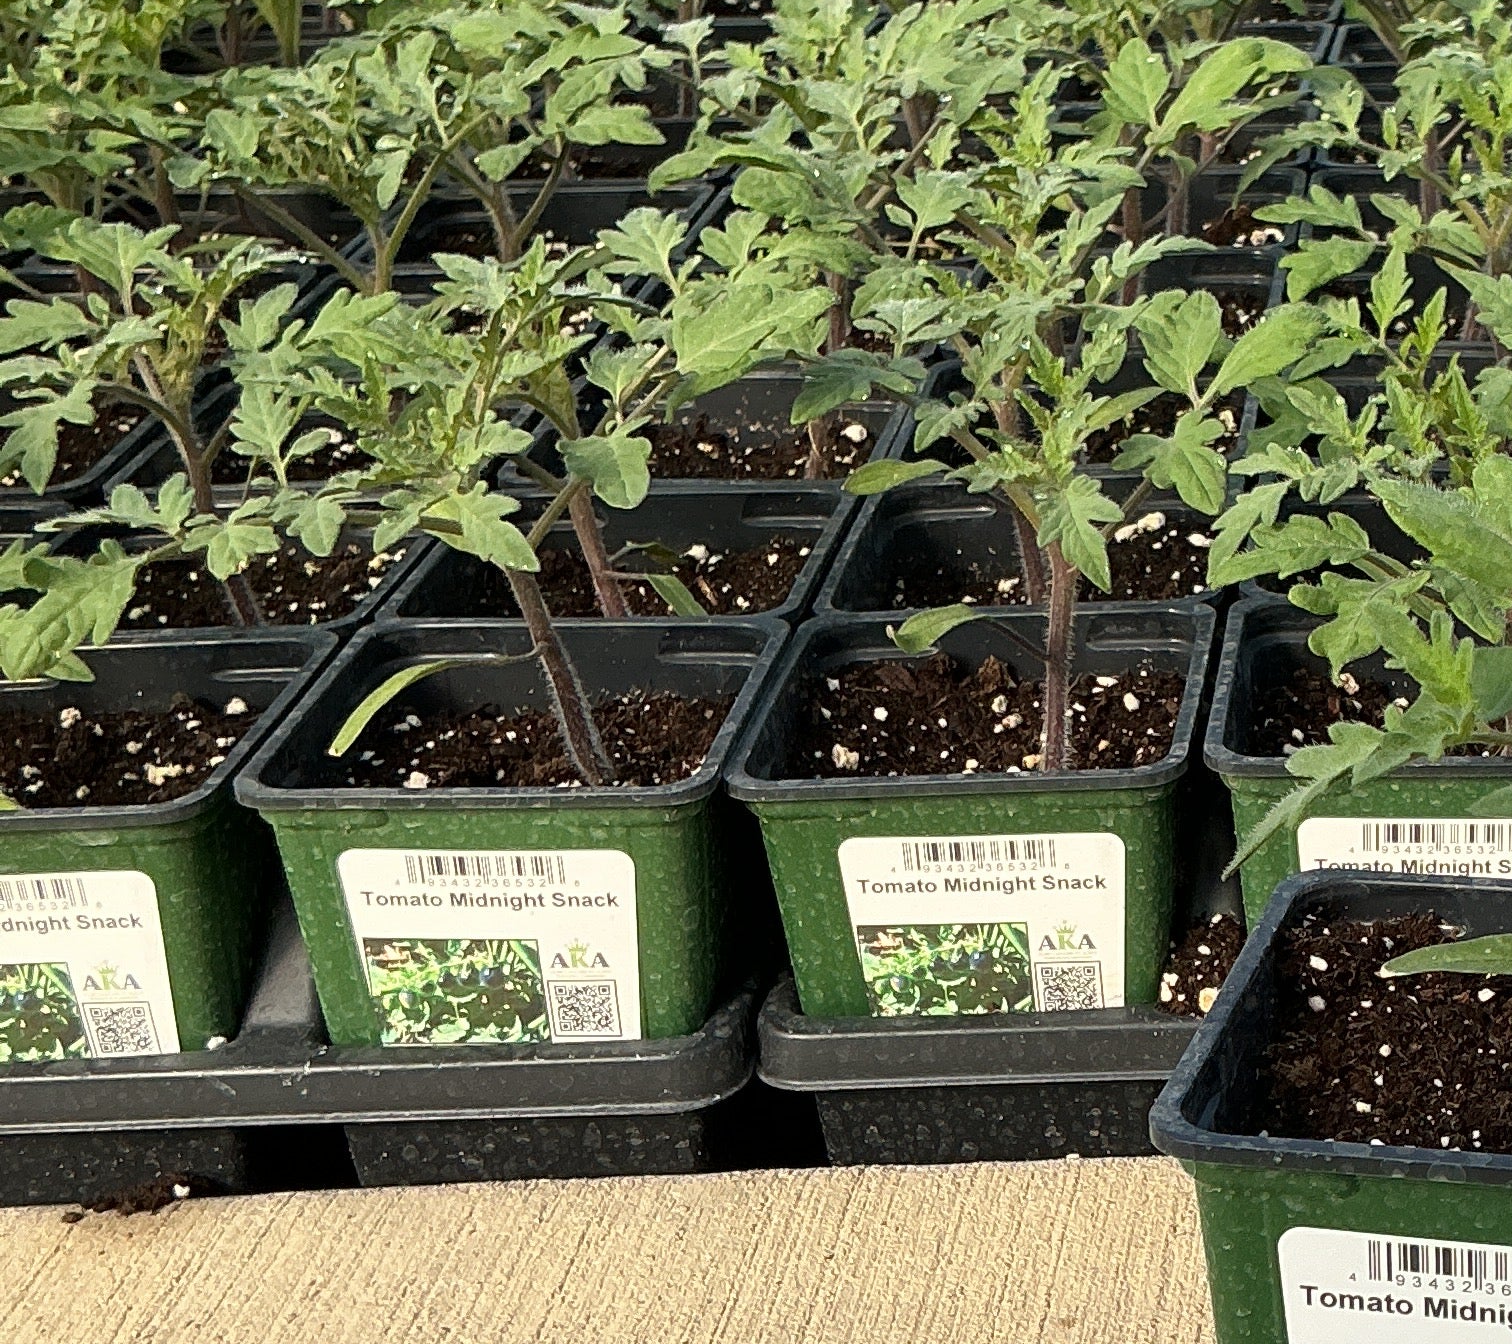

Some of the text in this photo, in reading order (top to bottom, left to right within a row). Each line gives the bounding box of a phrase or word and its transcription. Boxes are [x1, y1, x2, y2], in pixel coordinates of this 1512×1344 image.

[1314, 858, 1394, 873] Tomato
[1401, 859, 1493, 876] Midnight
[856, 874, 1108, 895] Tomato Midnight Snack
[360, 891, 620, 912] Tomato Midnight Snack
[1, 913, 143, 934] dnight Snack
[1038, 934, 1097, 950] AKA
[550, 952, 610, 968] AKA
[83, 973, 143, 991] AKA
[1348, 1272, 1357, 1282] 4
[1395, 1273, 1472, 1294] 93432
[1299, 1284, 1413, 1315] Tomato
